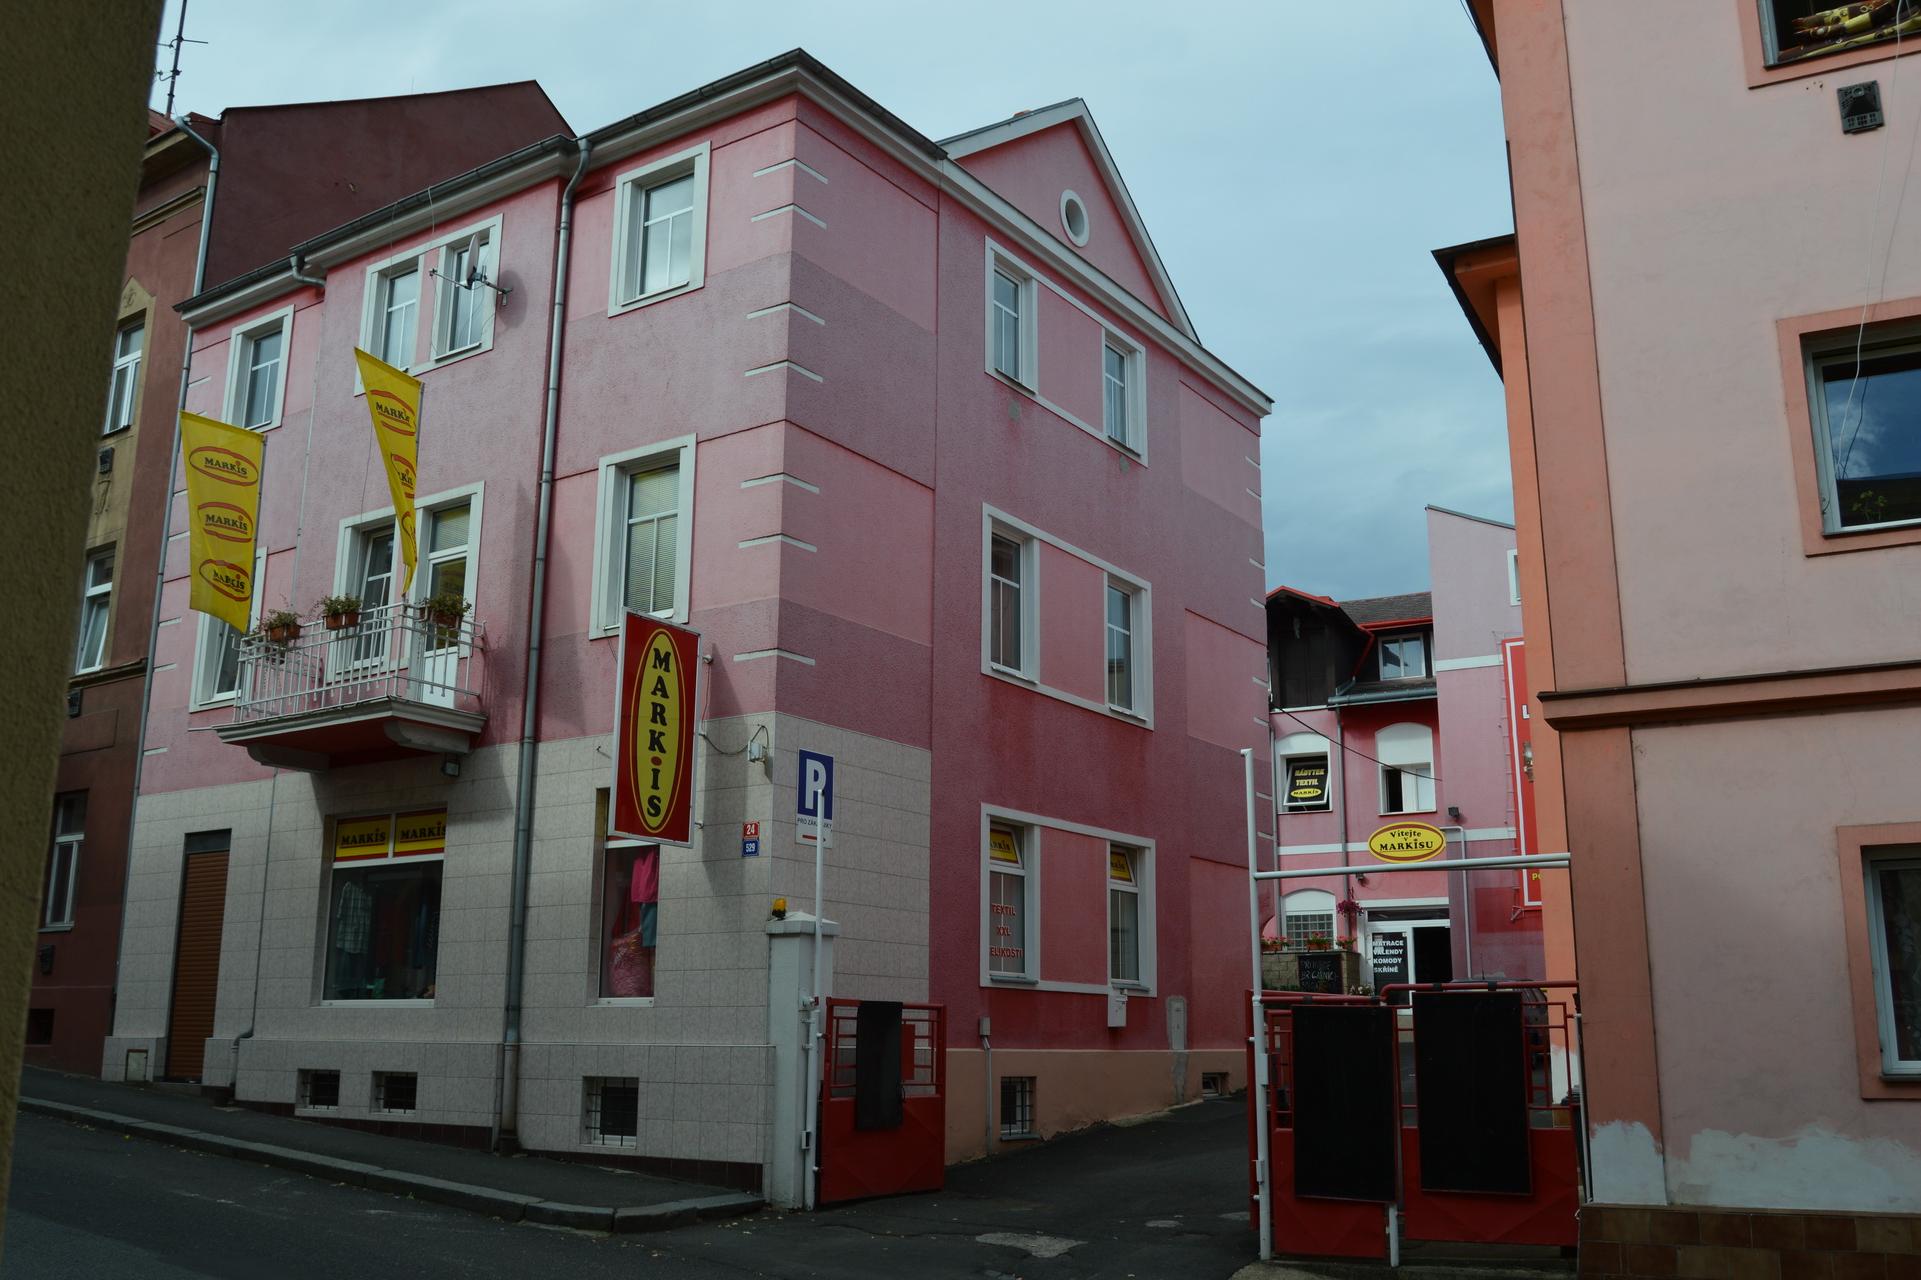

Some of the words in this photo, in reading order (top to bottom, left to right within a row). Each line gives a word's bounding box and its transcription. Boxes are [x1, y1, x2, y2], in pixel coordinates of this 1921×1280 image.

[647, 648, 671, 817] MARKIS
[804, 758, 827, 810] P
[1296, 778, 1319, 787] TEXTIL
[746, 824, 755, 835] 24
[991, 904, 1016, 916] TEXTIL
[997, 926, 1011, 937] XXL
